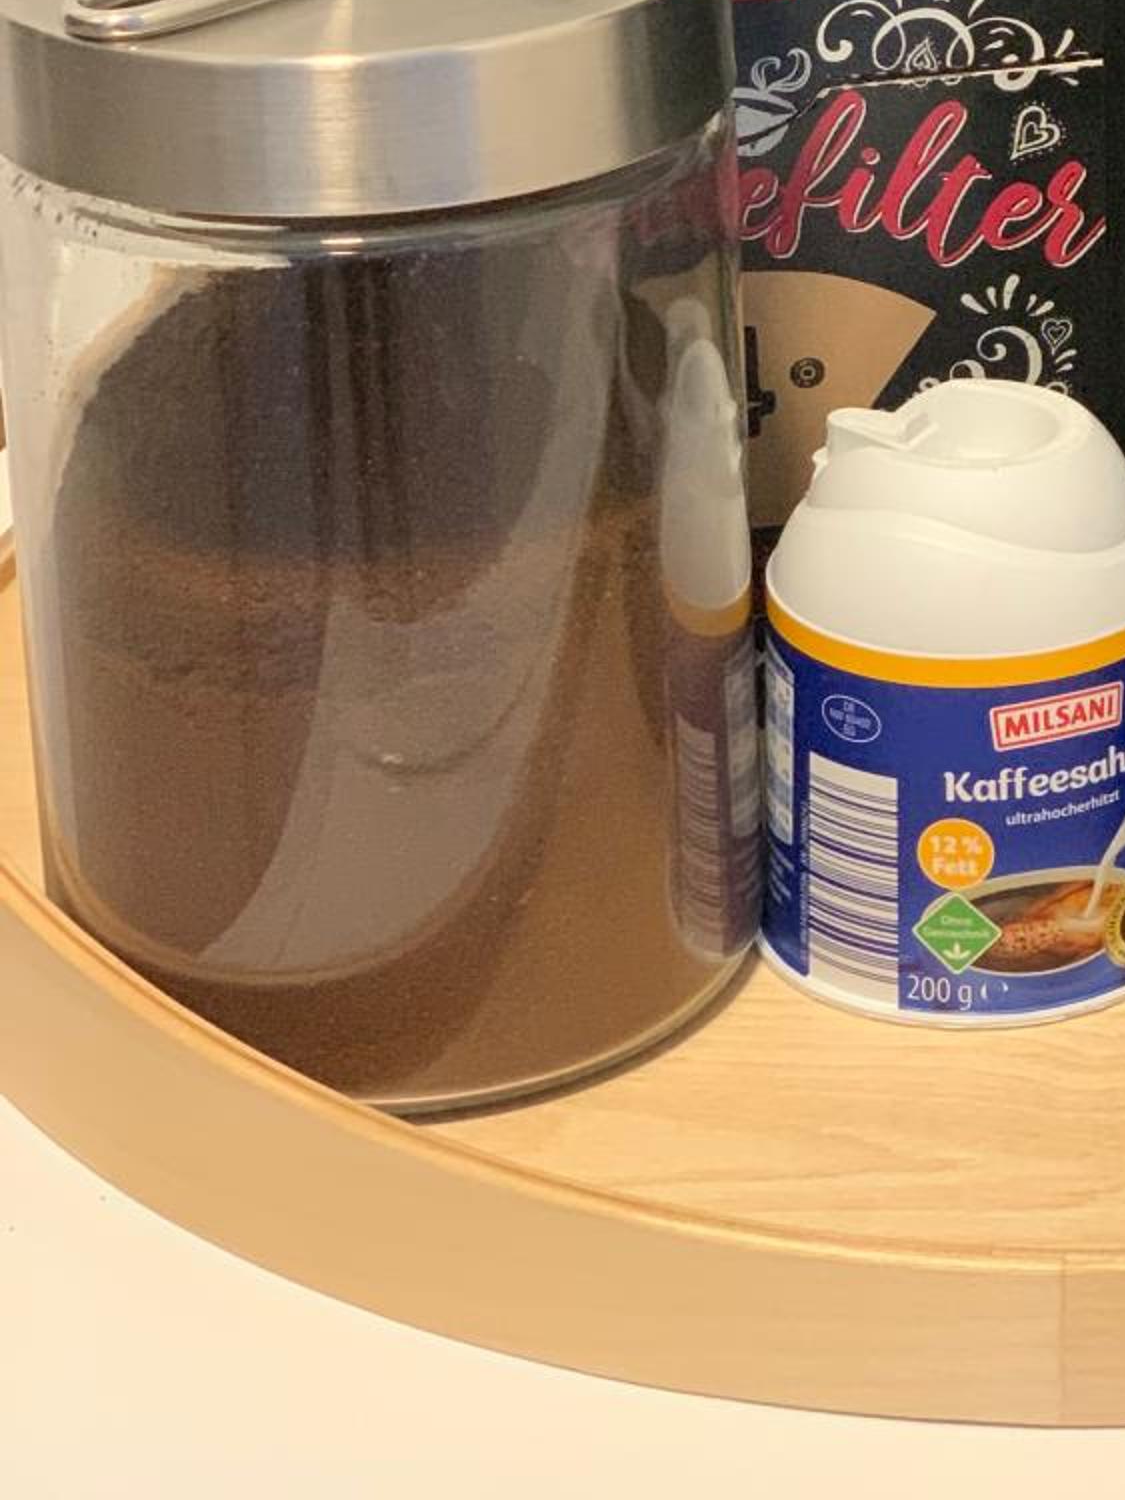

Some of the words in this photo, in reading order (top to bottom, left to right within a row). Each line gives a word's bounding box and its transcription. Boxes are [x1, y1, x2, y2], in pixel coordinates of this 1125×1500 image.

[1003, 693, 1115, 740] MILSANI
[1005, 789, 1121, 826] ultrahocherhitzt
[929, 835, 958, 854] 12
[932, 856, 979, 877] Fett
[906, 973, 951, 1003] 200
[957, 983, 974, 1012] g
